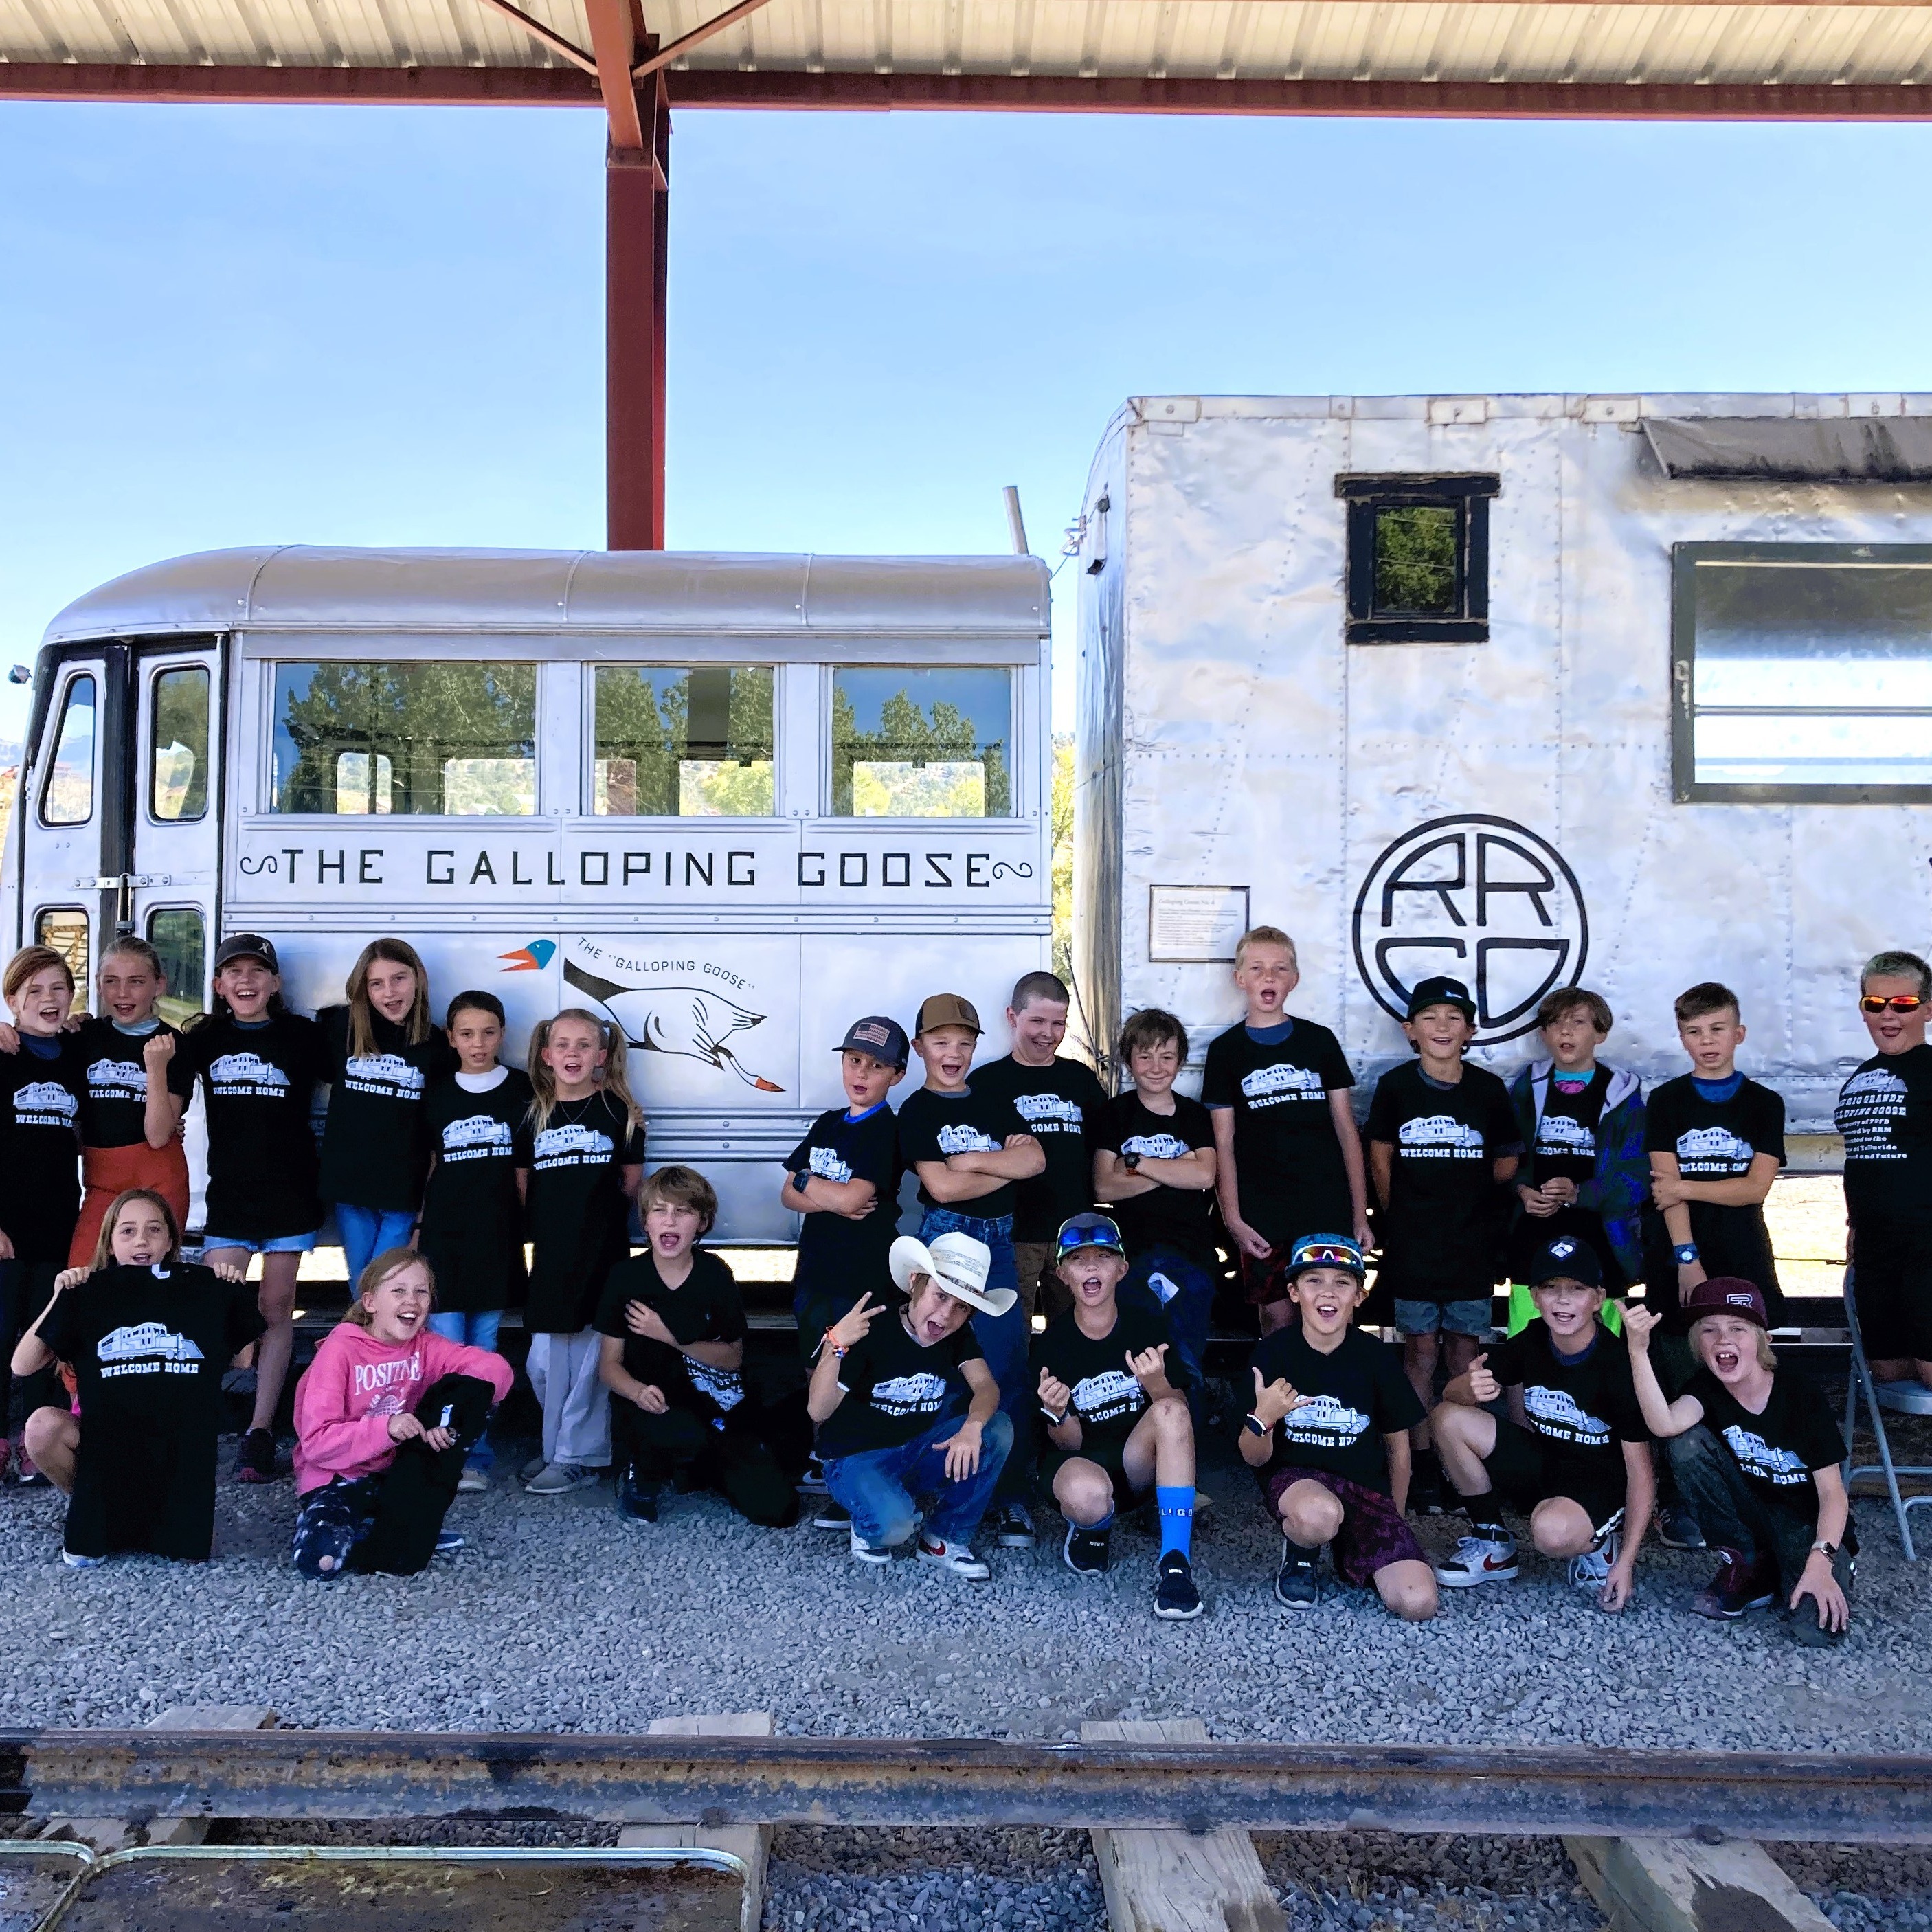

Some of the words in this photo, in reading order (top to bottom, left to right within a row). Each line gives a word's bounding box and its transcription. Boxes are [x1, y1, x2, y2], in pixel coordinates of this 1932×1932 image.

[282, 849, 384, 884] THE
[426, 850, 755, 886] GALLOPING
[798, 852, 990, 888] GOOSE
[577, 937, 603, 959] THE
[255, 1086, 285, 1097] HOME
[344, 1079, 393, 1096] WELCOME
[396, 1088, 420, 1100] HOM
[133, 1094, 147, 1102] HO
[1247, 1093, 1297, 1110] WELCOME
[1301, 1091, 1326, 1100] HOM
[1863, 1094, 1905, 1104] GRANDE
[1872, 1106, 1907, 1116] GOOSE
[16, 1114, 60, 1125] WELCOME
[1031, 1123, 1059, 1132] COME
[443, 1148, 488, 1162] WELCOME
[491, 1147, 513, 1156] HOM
[1400, 1149, 1450, 1158] WELCOME
[1453, 1149, 1483, 1158] HOME
[1571, 1147, 1595, 1156] HOM
[533, 1156, 579, 1170] WELCOME
[100, 1362, 160, 1378] WELCOME
[164, 1362, 199, 1373] HOME
[870, 1402, 917, 1416] WELCOE
[1089, 1404, 1126, 1423] LCOME
[1284, 1428, 1334, 1447] WELCOME
[1539, 1424, 1571, 1441] COME
[1575, 1435, 1609, 1445] HOME
[1772, 1473, 1808, 1485] HOME
